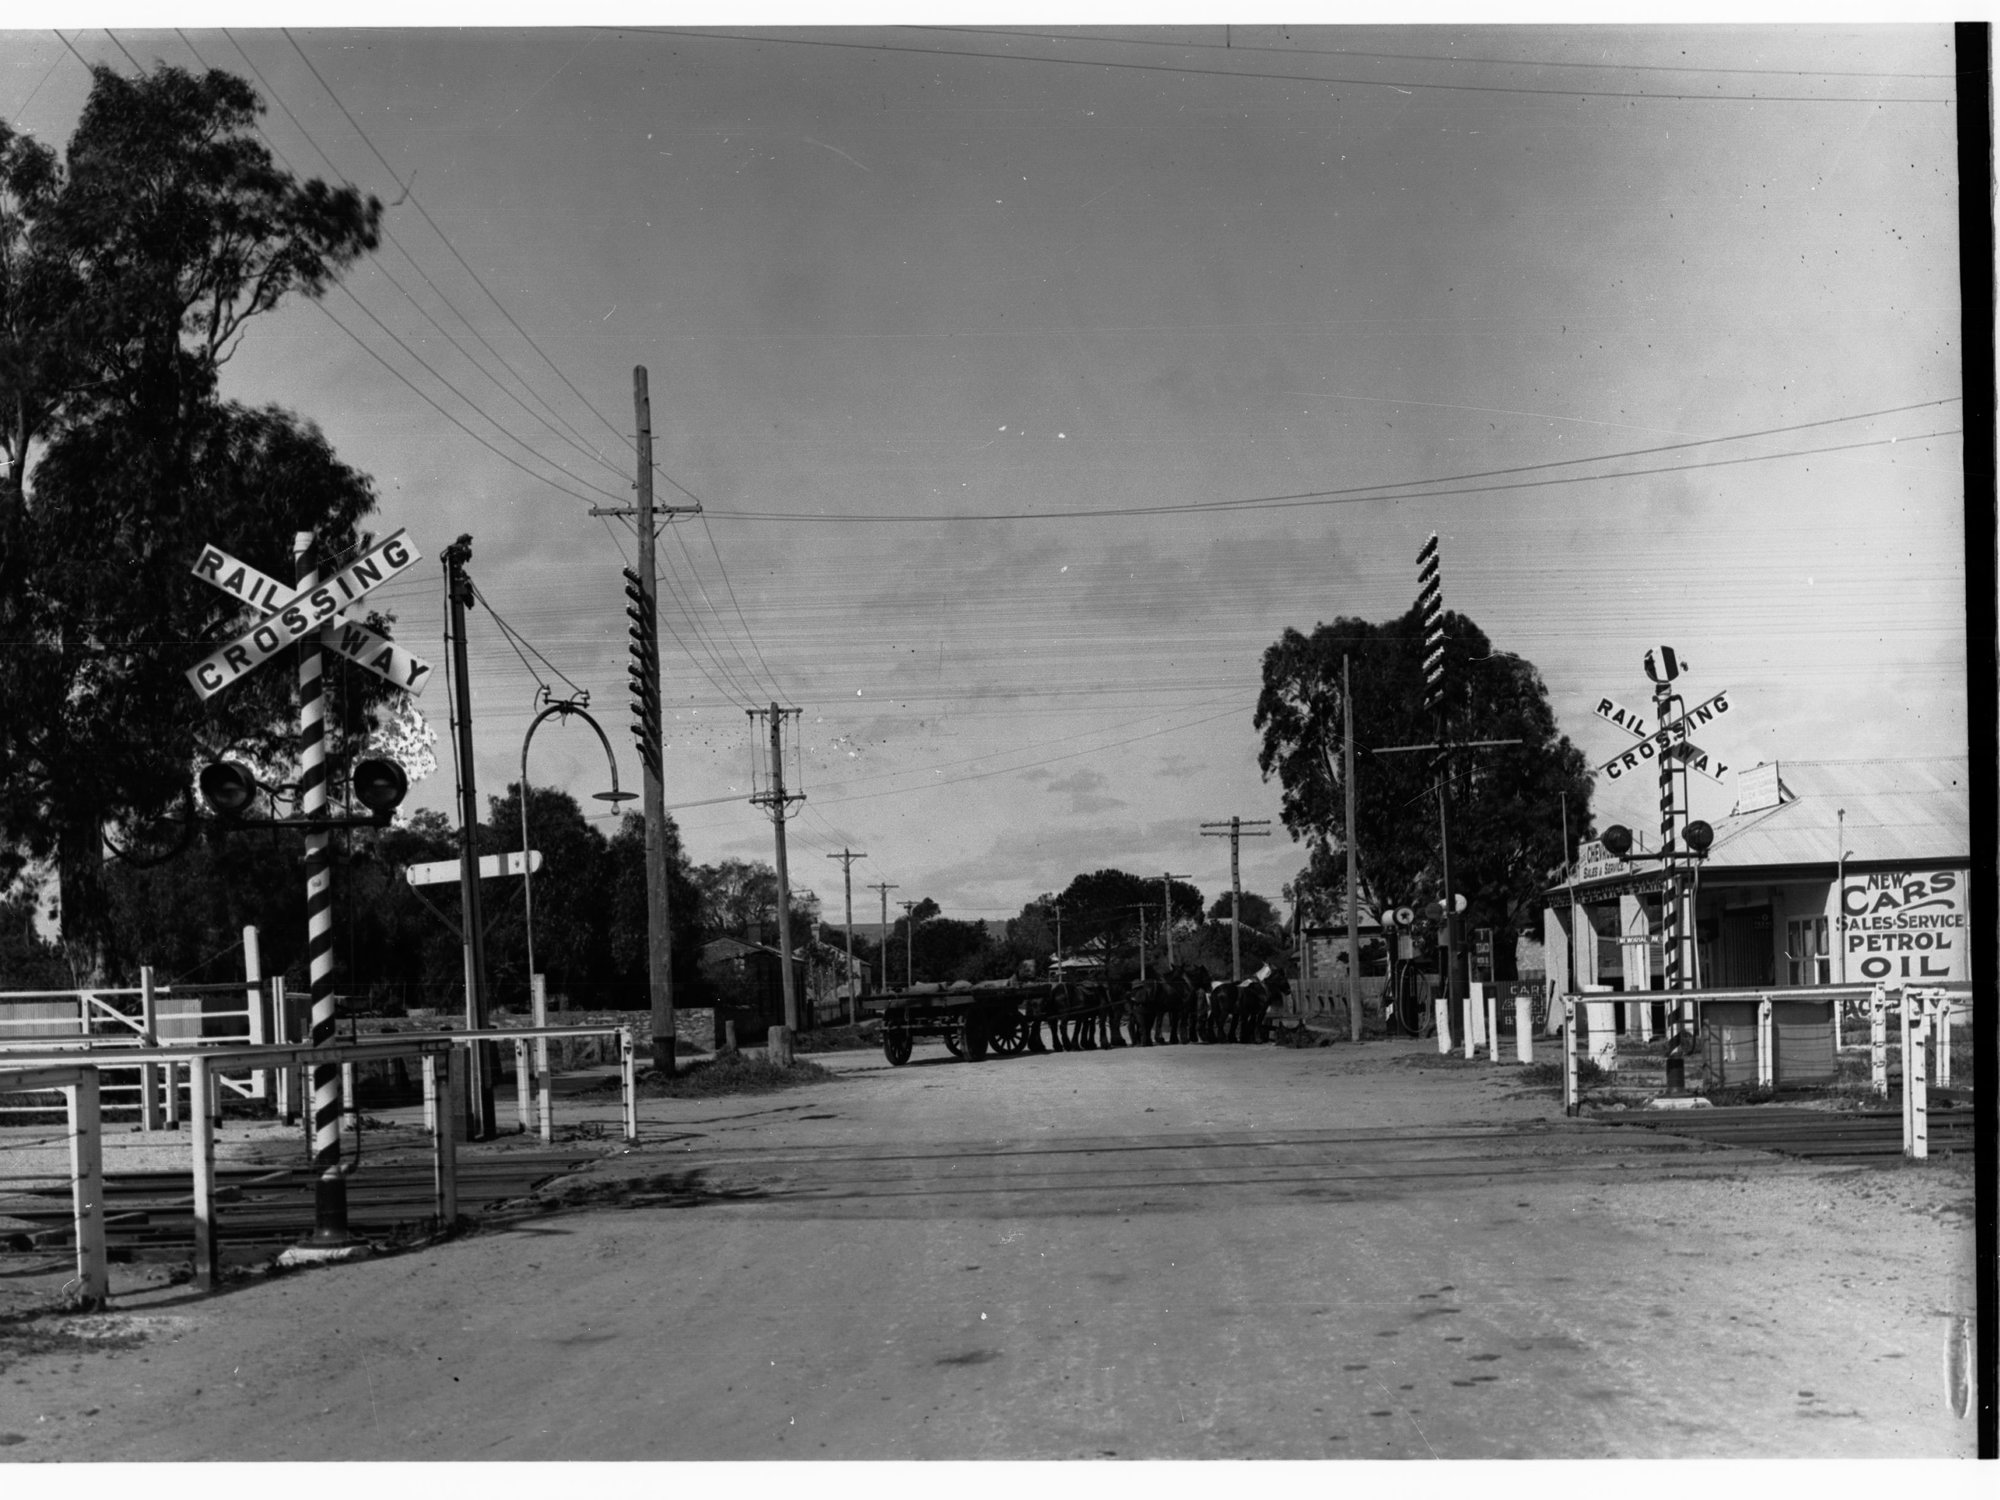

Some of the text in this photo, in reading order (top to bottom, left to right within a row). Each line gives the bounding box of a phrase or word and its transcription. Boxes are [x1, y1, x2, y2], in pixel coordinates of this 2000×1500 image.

[197, 540, 410, 691] CROSSING
[197, 549, 429, 687] RAIL WAY
[1597, 698, 1728, 778] RAIL WAY
[1606, 696, 1729, 779] CROSSING
[1604, 862, 1625, 876] SERVICE
[1867, 871, 1912, 890] NEW
[1842, 871, 1956, 917] CARS
[1836, 913, 1892, 931] SALES
[1897, 912, 1965, 930] SERVICE
[1849, 932, 1952, 953] PETROL
[1860, 955, 1950, 979] OIL
